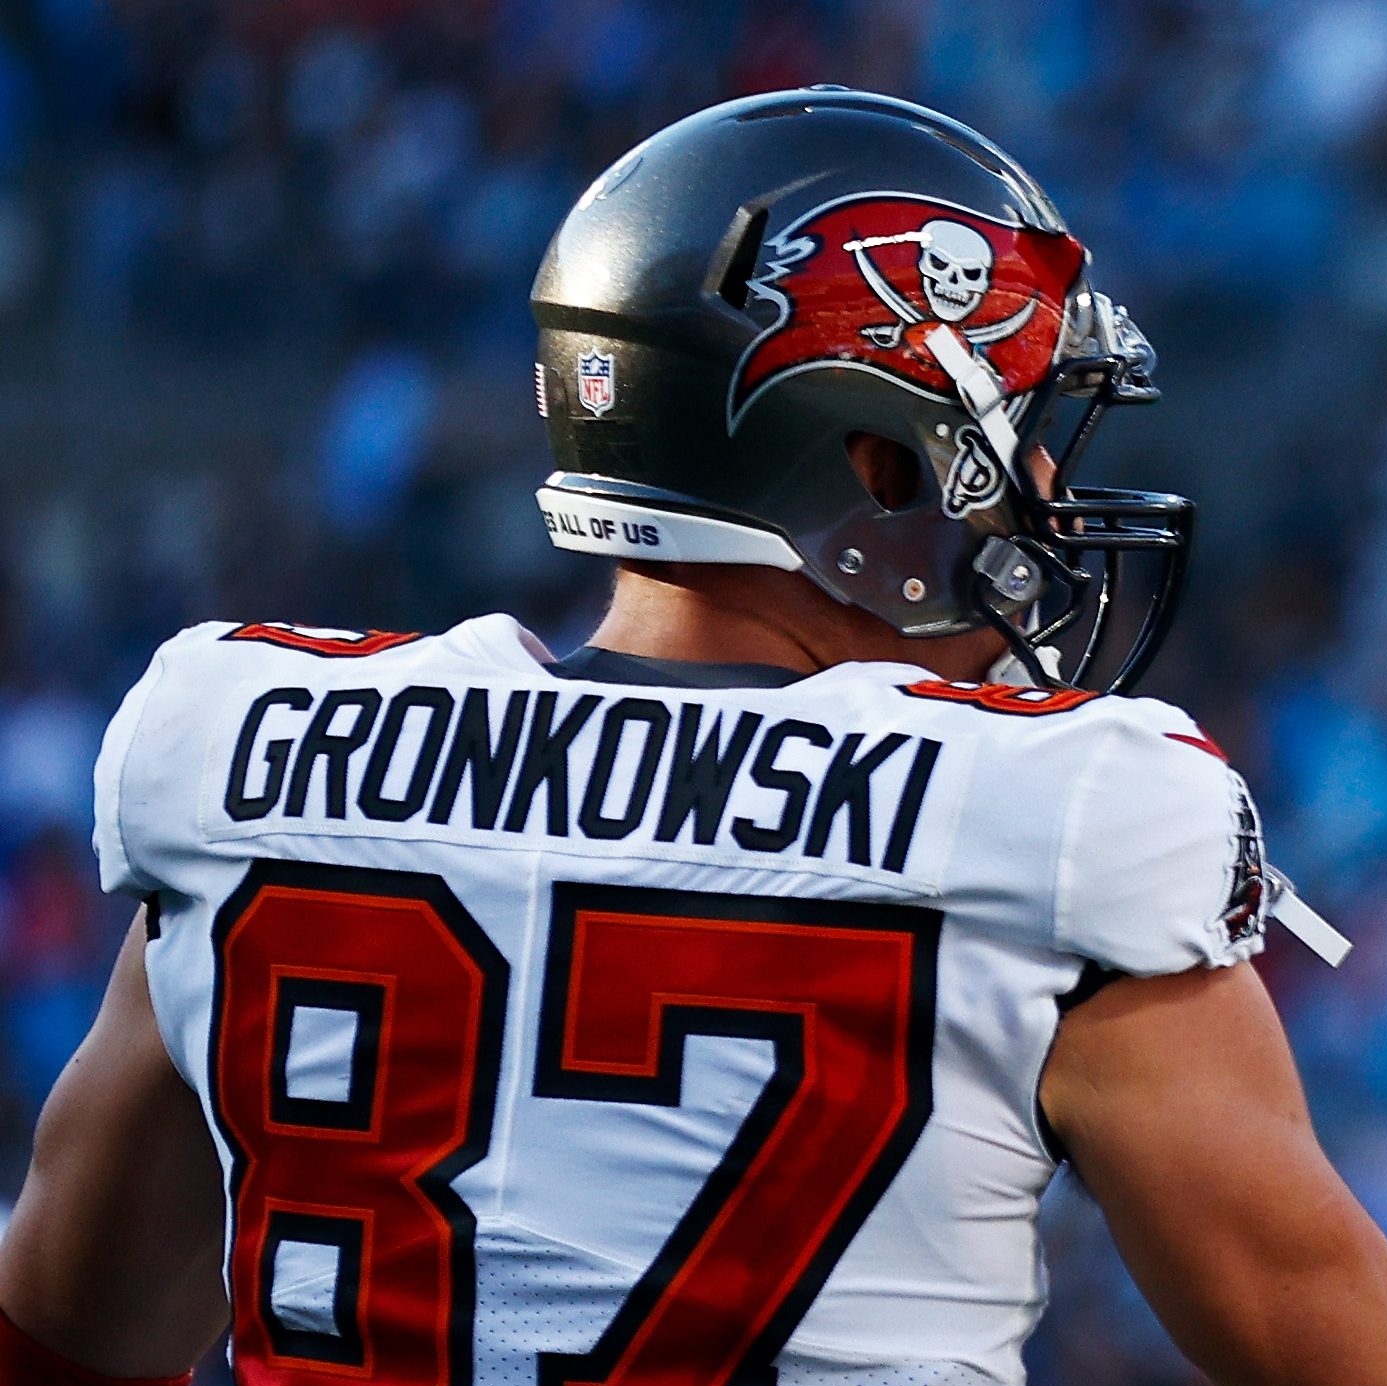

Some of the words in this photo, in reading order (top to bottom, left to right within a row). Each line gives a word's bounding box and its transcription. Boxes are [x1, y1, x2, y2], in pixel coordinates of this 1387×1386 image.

[558, 512, 587, 537] ALL
[590, 517, 616, 540] OF
[623, 521, 660, 547] US
[224, 686, 942, 873] GRONKOWSKI
